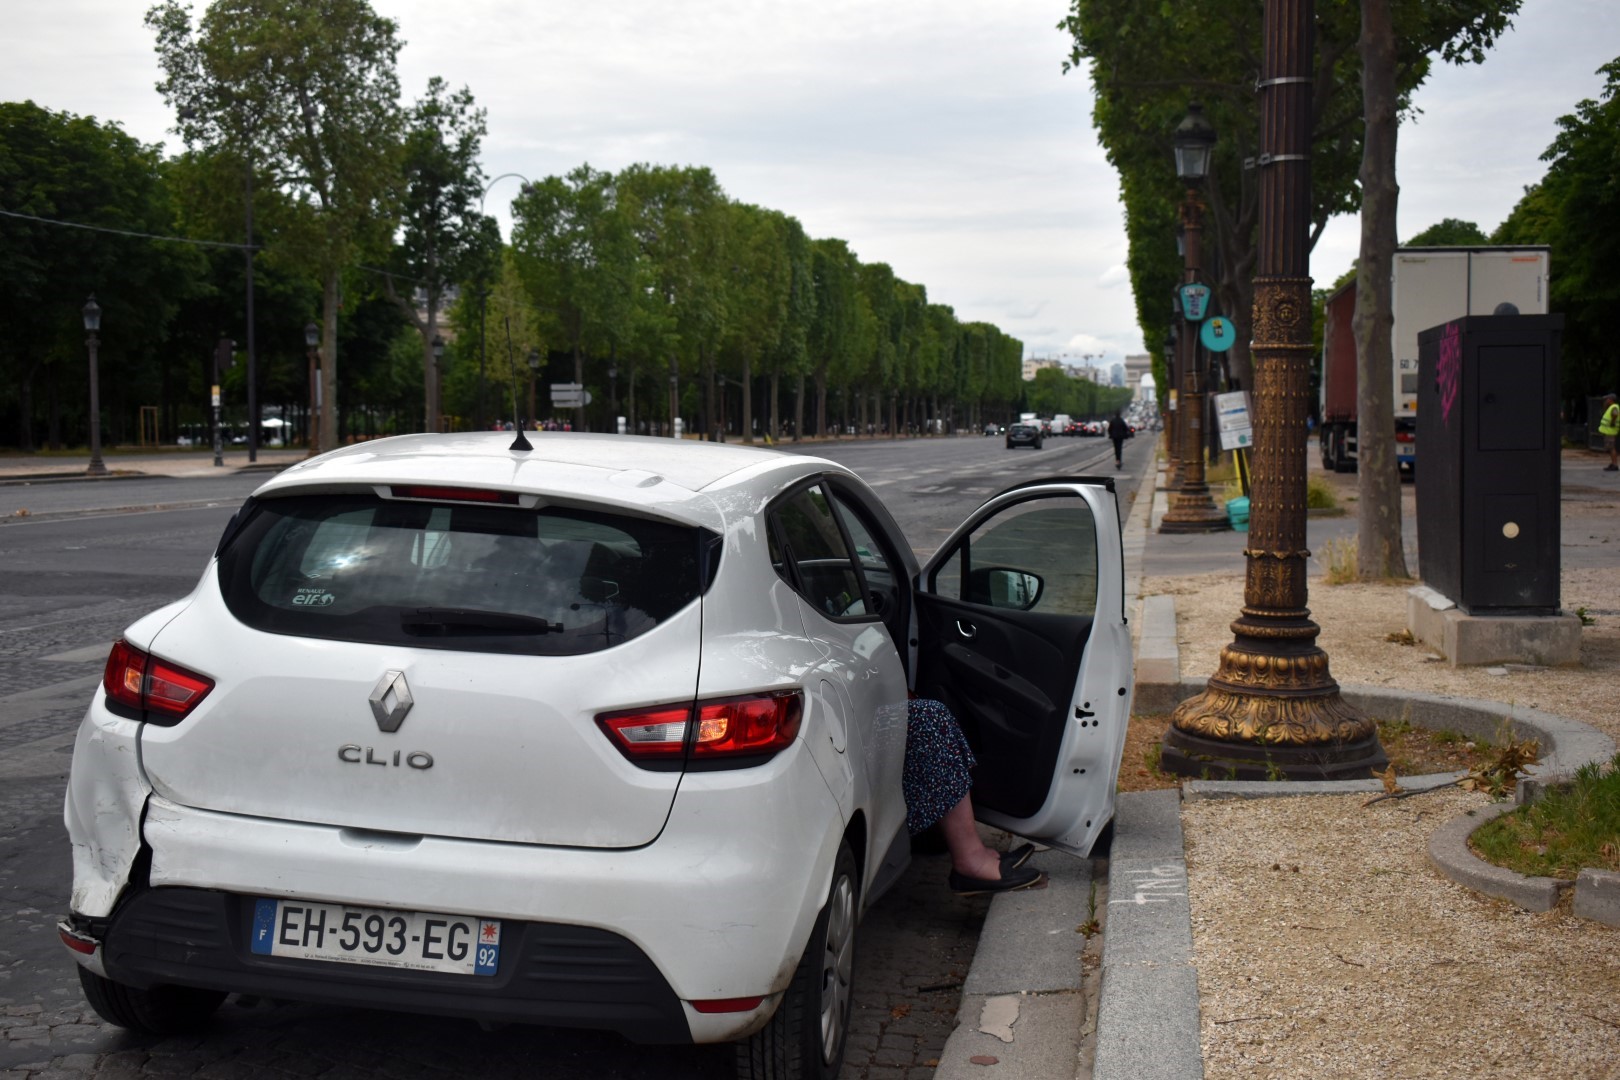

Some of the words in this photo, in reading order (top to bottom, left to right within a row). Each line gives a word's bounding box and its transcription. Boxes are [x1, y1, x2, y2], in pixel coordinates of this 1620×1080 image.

[292, 594, 320, 605] elf
[338, 743, 434, 770] CLIO
[259, 929, 267, 941] F
[279, 906, 470, 961] EH-593-EG
[479, 948, 496, 967] 92
